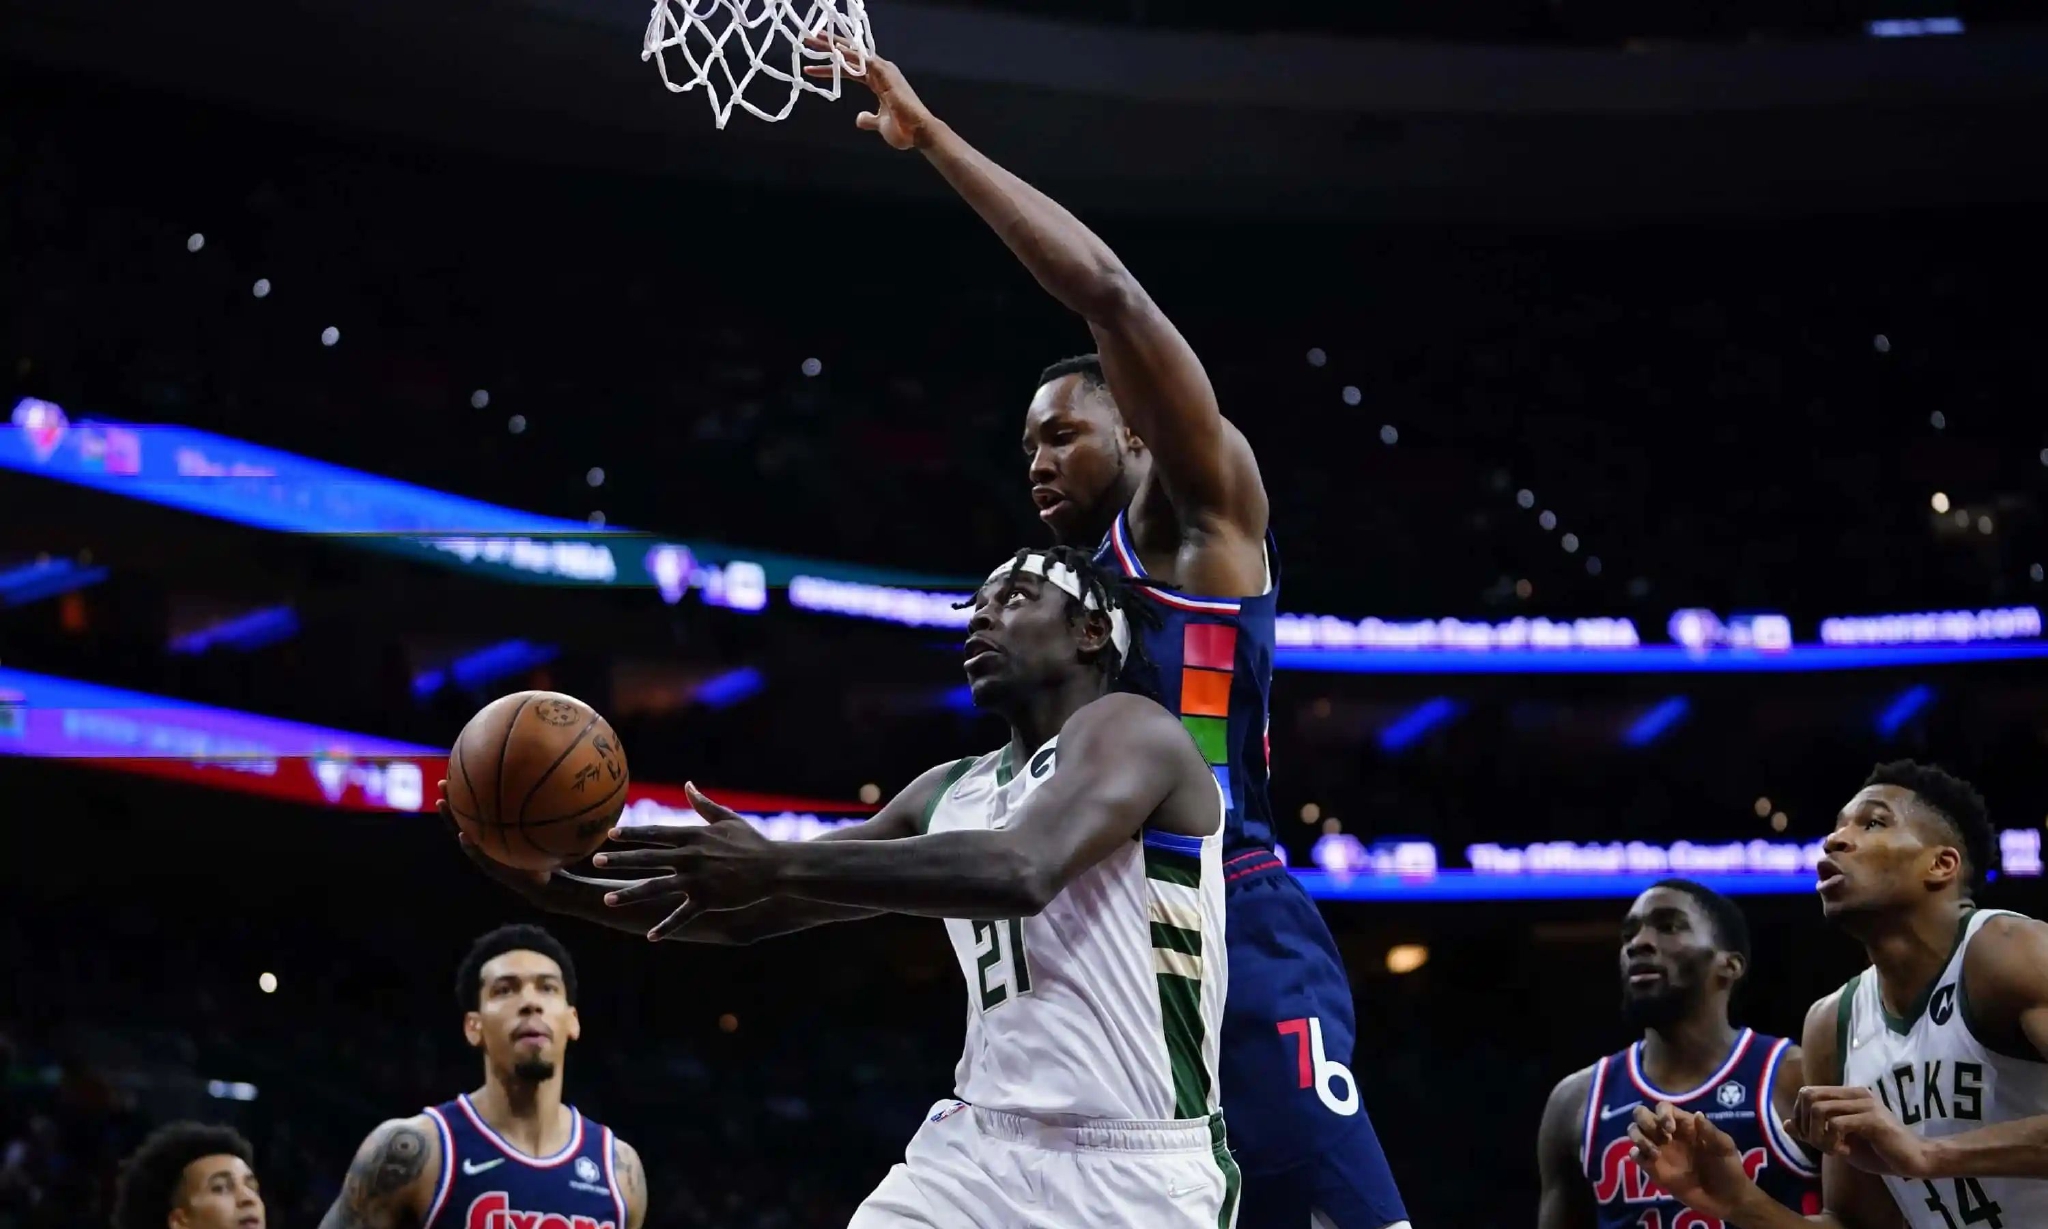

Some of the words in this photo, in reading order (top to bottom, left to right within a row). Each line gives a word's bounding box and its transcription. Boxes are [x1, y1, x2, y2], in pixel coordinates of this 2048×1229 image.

[972, 919, 1034, 1014] 21
[1277, 1017, 1360, 1116] 76
[1868, 1059, 1983, 1126] CKS
